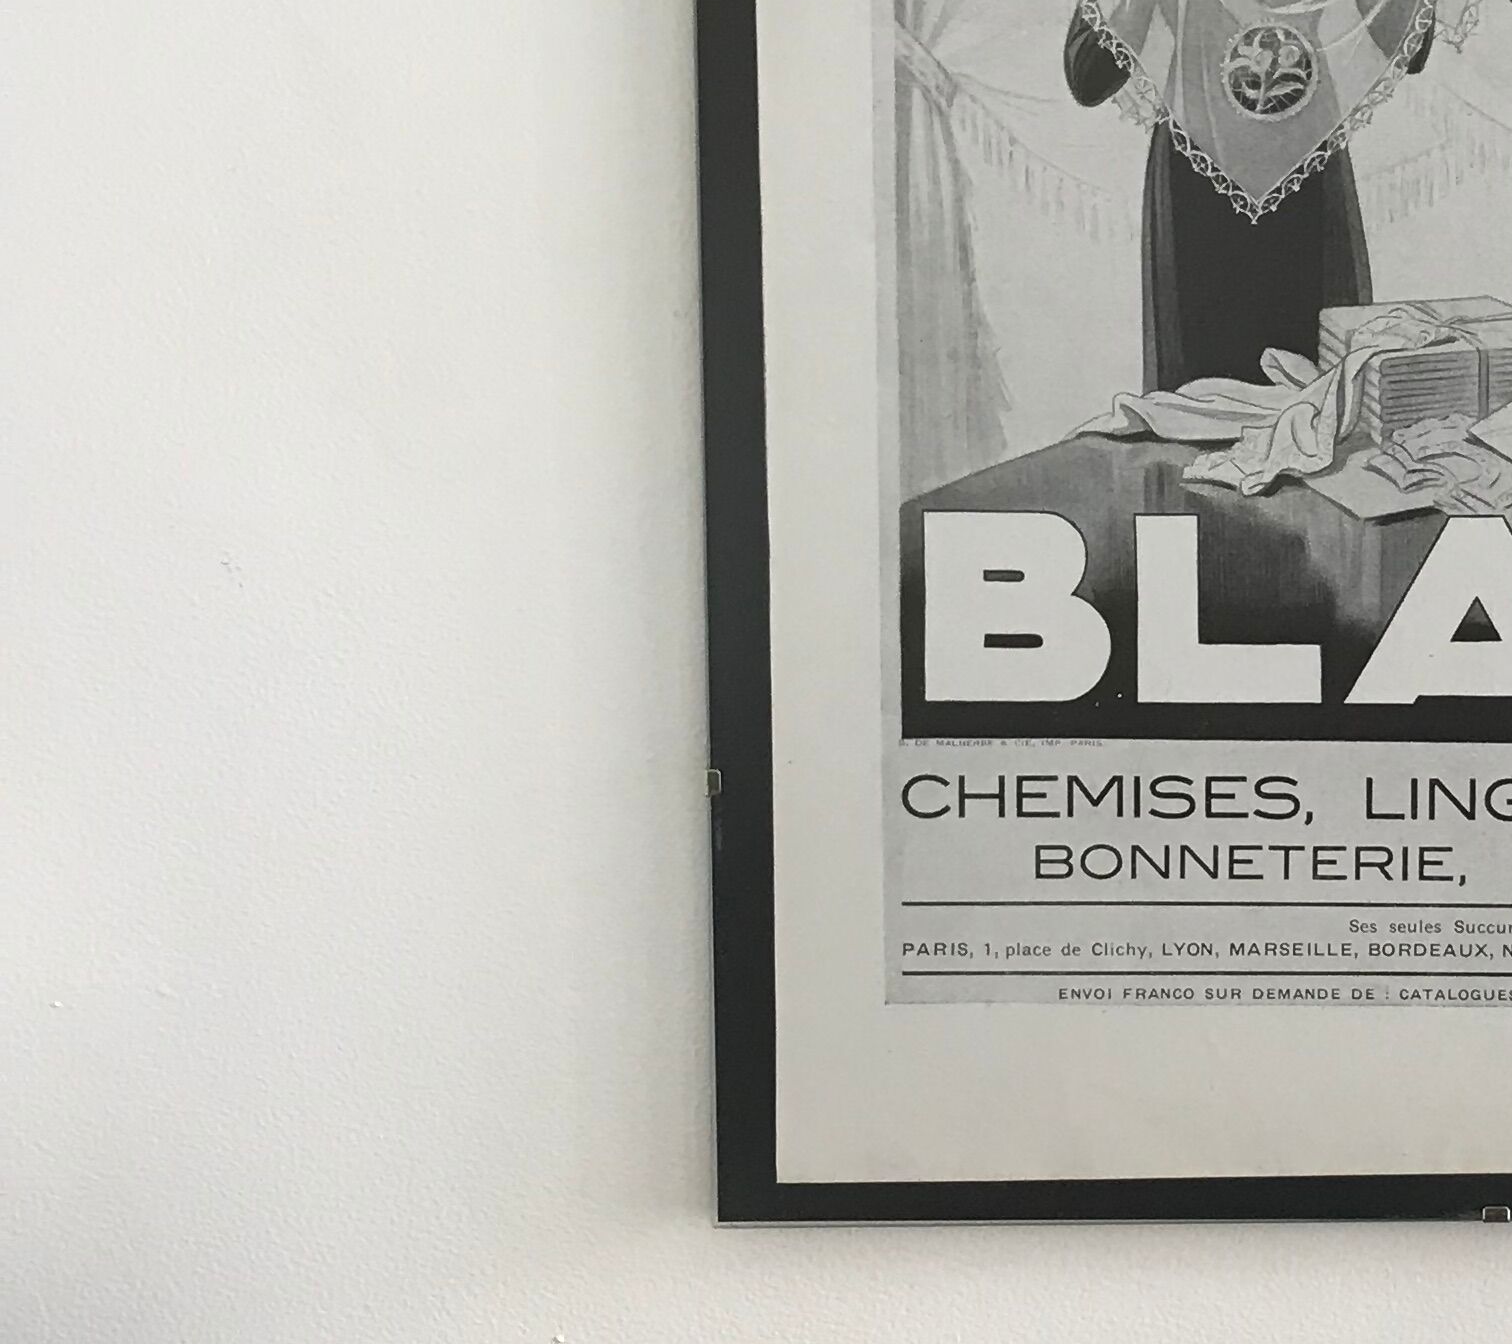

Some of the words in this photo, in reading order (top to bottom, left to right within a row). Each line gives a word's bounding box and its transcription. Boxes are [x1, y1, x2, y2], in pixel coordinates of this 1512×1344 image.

[901, 774, 1313, 826] CHEMISES,
[1035, 844, 1466, 887] BONNETERIE,
[1349, 919, 1377, 935] Ses
[1387, 920, 1443, 936] seules
[902, 942, 973, 959] PARIS,
[1006, 942, 1051, 960] place
[1061, 942, 1083, 956] de
[1092, 942, 1152, 959] Clichy,
[1162, 942, 1219, 959] LYON,
[1230, 942, 1358, 960] MARSEILLE,
[1368, 940, 1493, 960] BORDEAUX,
[1059, 988, 1111, 1000] ENVOI
[1123, 987, 1195, 1001] FRANCO
[1204, 987, 1243, 1001] SUR
[1252, 987, 1341, 1002] DEMANDE
[1351, 988, 1376, 1002] DE
